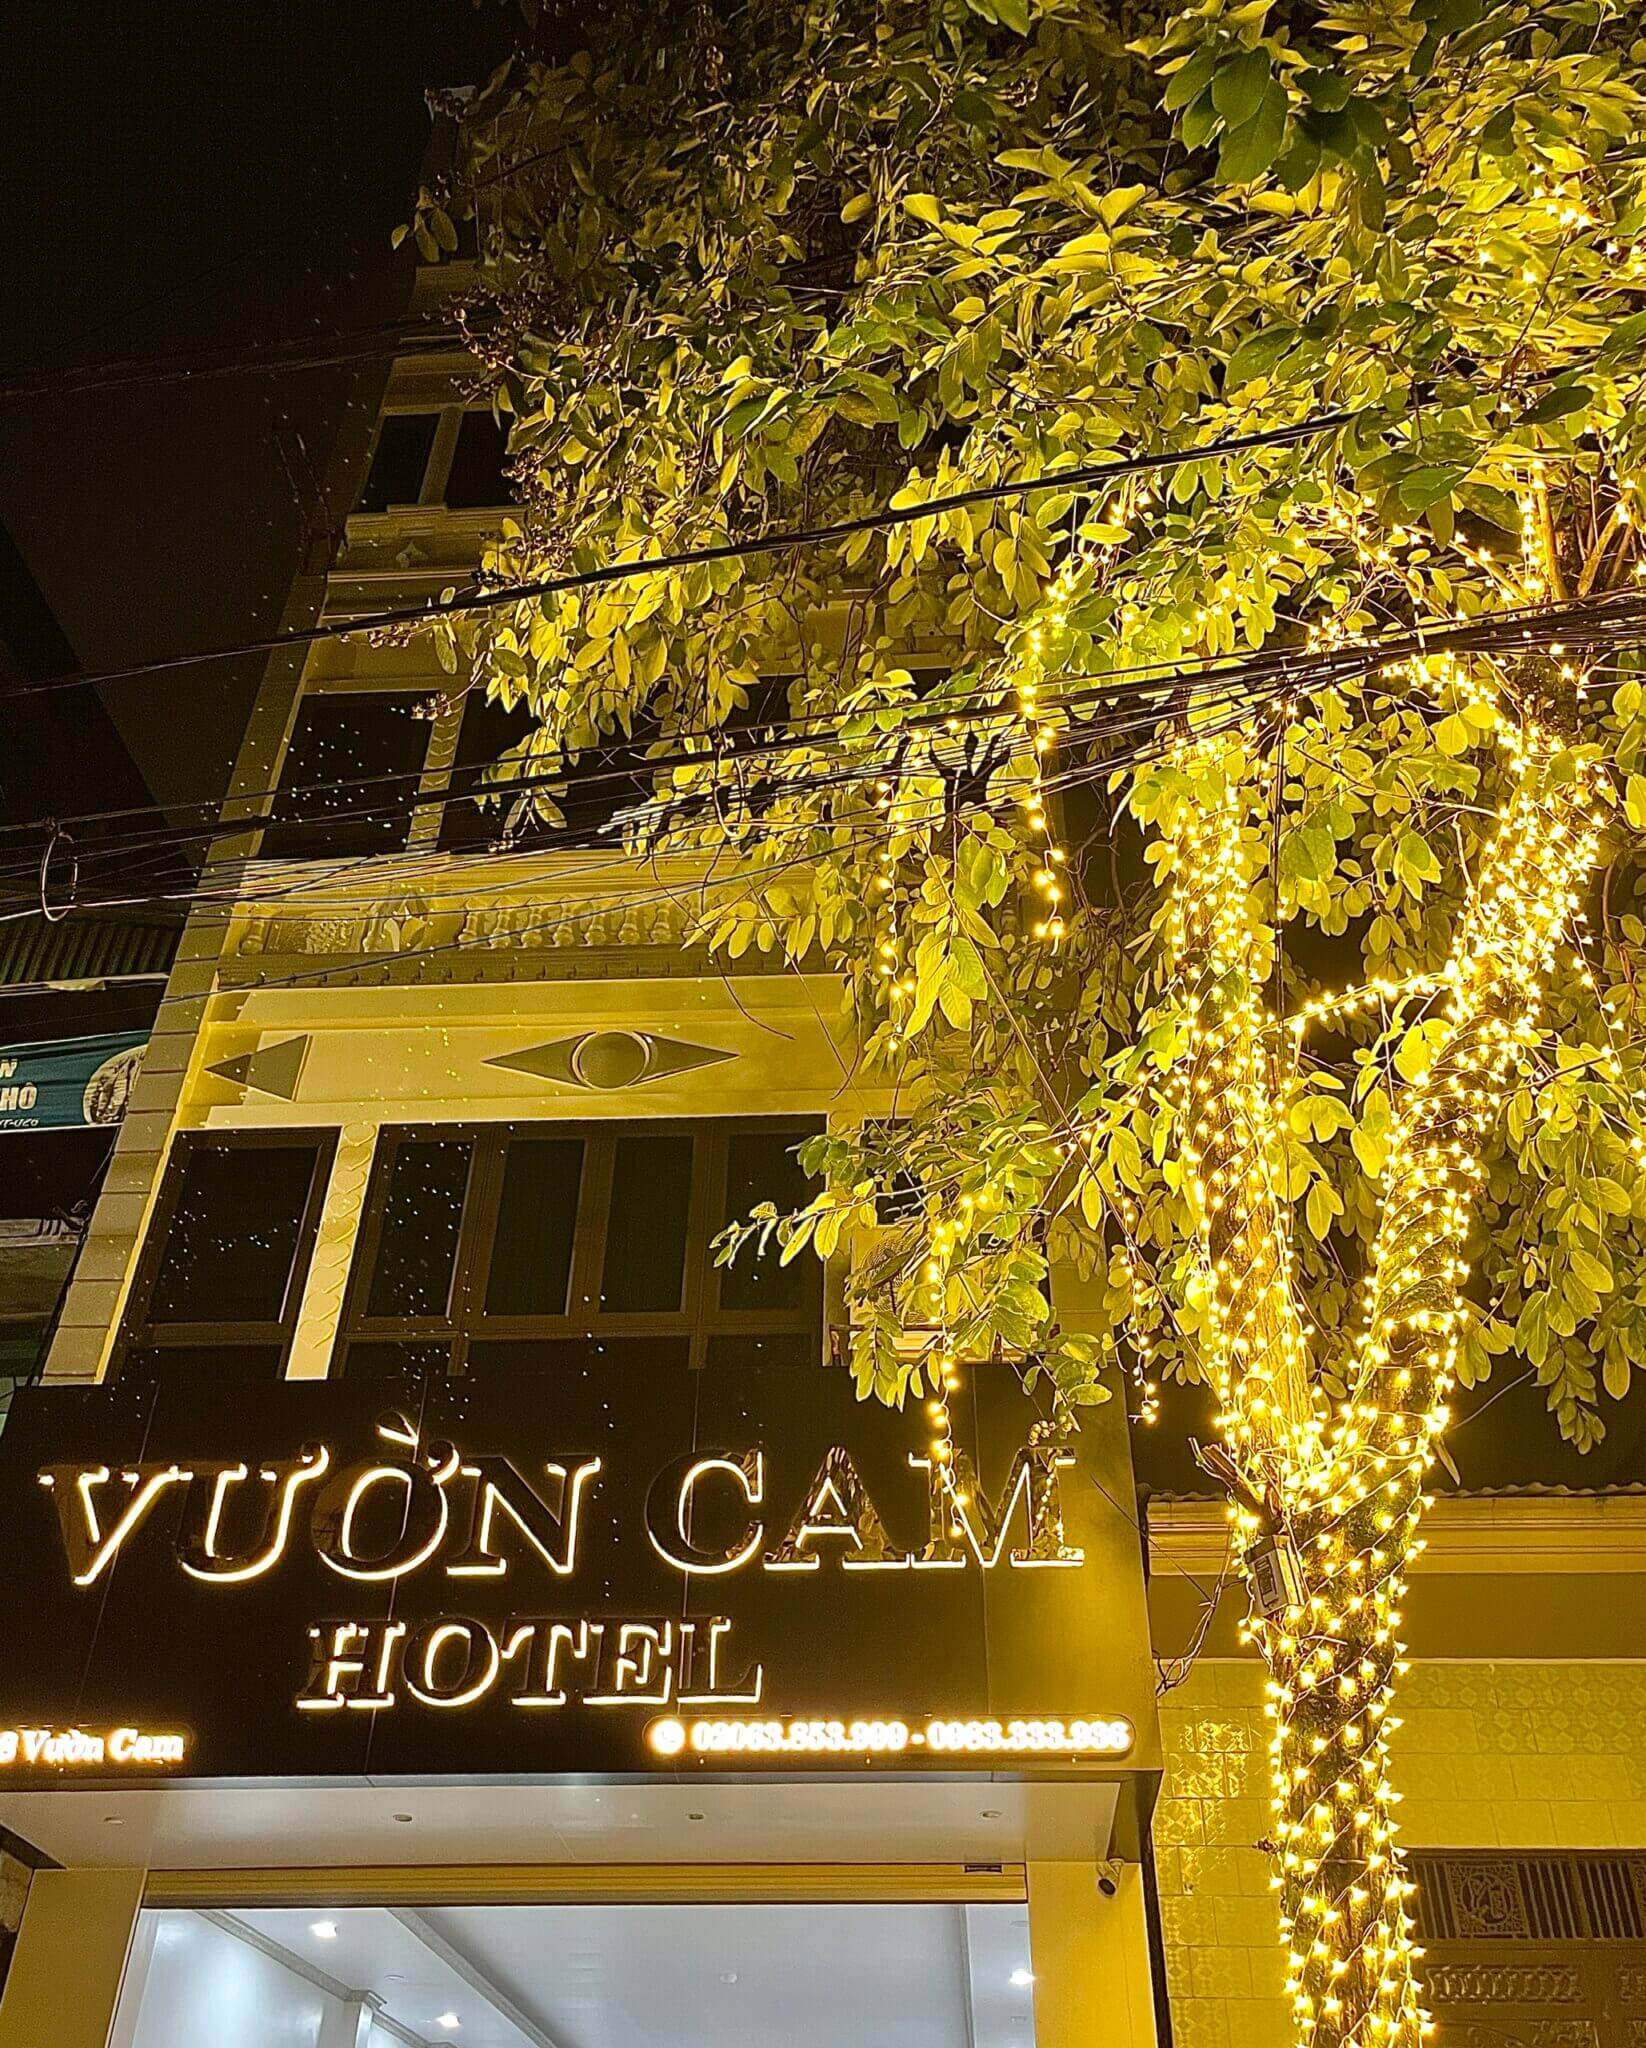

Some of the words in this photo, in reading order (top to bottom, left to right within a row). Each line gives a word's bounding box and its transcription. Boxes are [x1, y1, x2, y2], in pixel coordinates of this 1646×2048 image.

[37, 1410, 602, 1586] VƯỜN
[645, 1445, 1085, 1574] CAM
[296, 1616, 763, 1709] HOTEL
[109, 1728, 184, 1762] Cam
